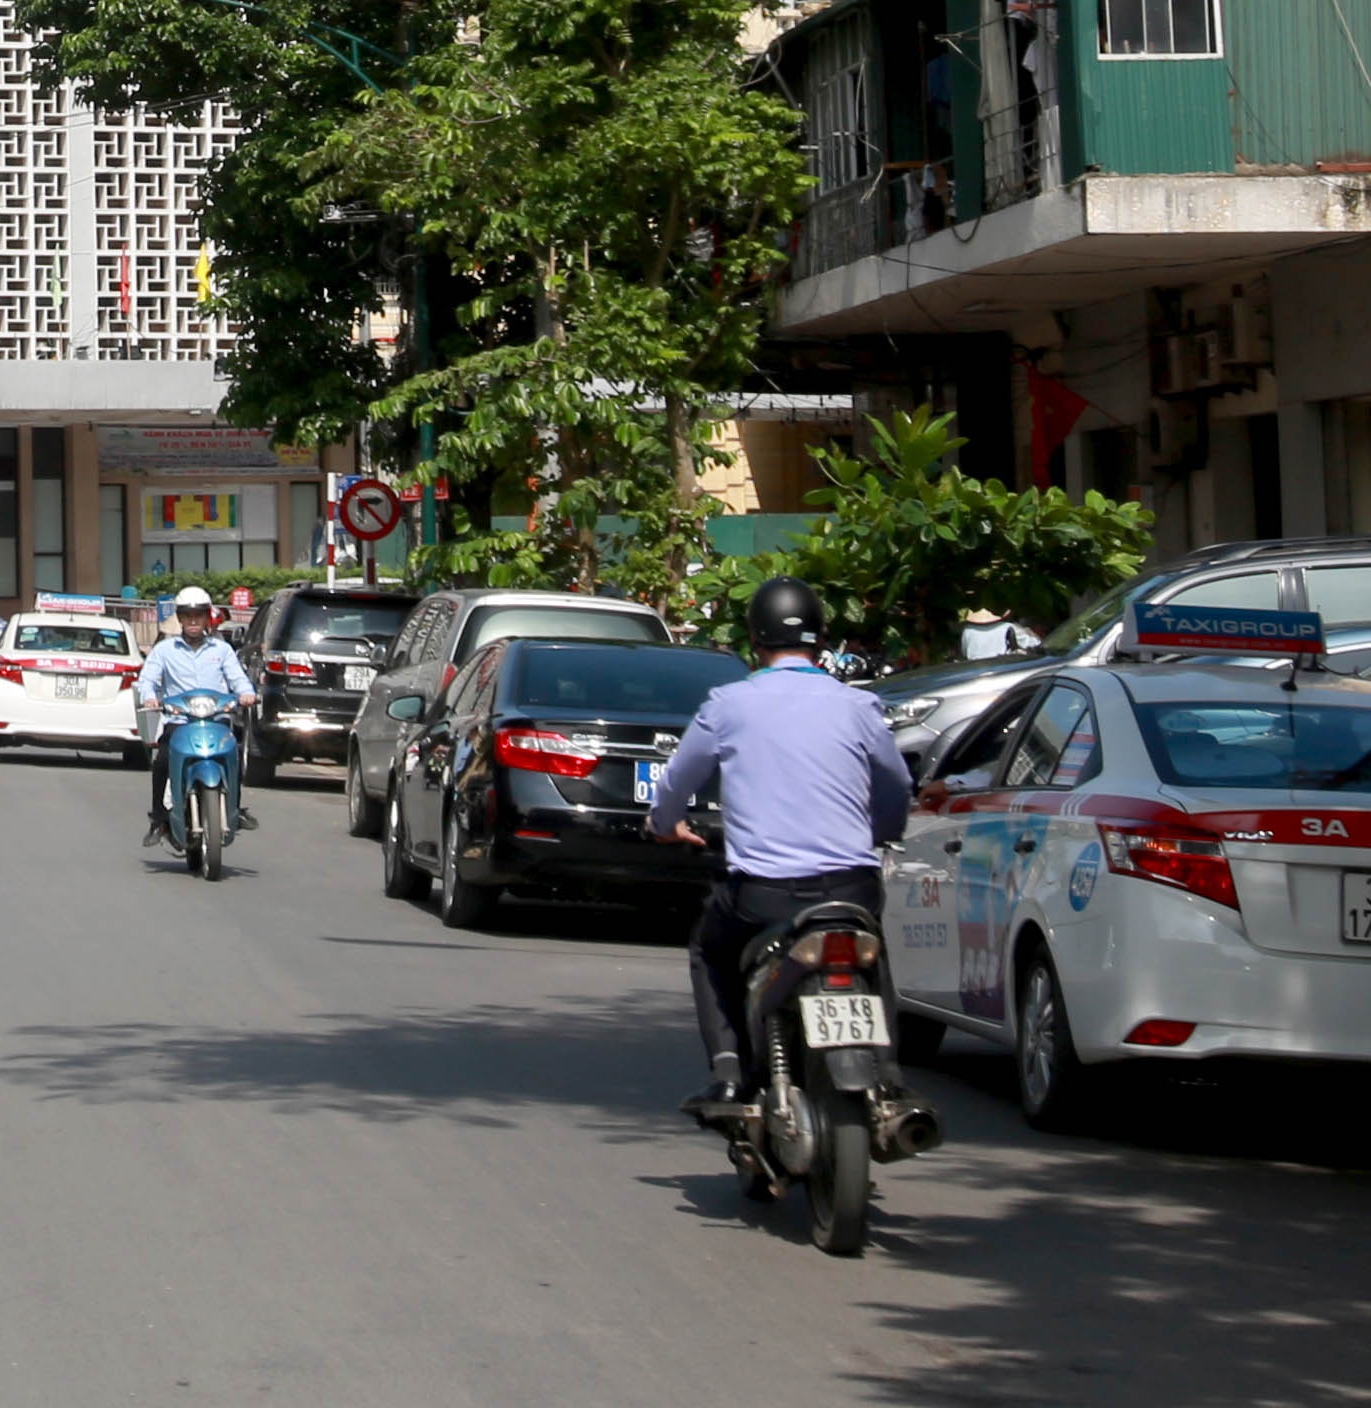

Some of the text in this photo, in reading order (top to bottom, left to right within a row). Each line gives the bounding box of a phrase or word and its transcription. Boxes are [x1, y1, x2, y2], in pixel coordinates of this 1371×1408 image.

[1161, 616, 1316, 638] TAXIGROUP
[1300, 817, 1349, 838] 3A
[814, 997, 874, 1018] 36-K8
[817, 1019, 875, 1041] 9767
